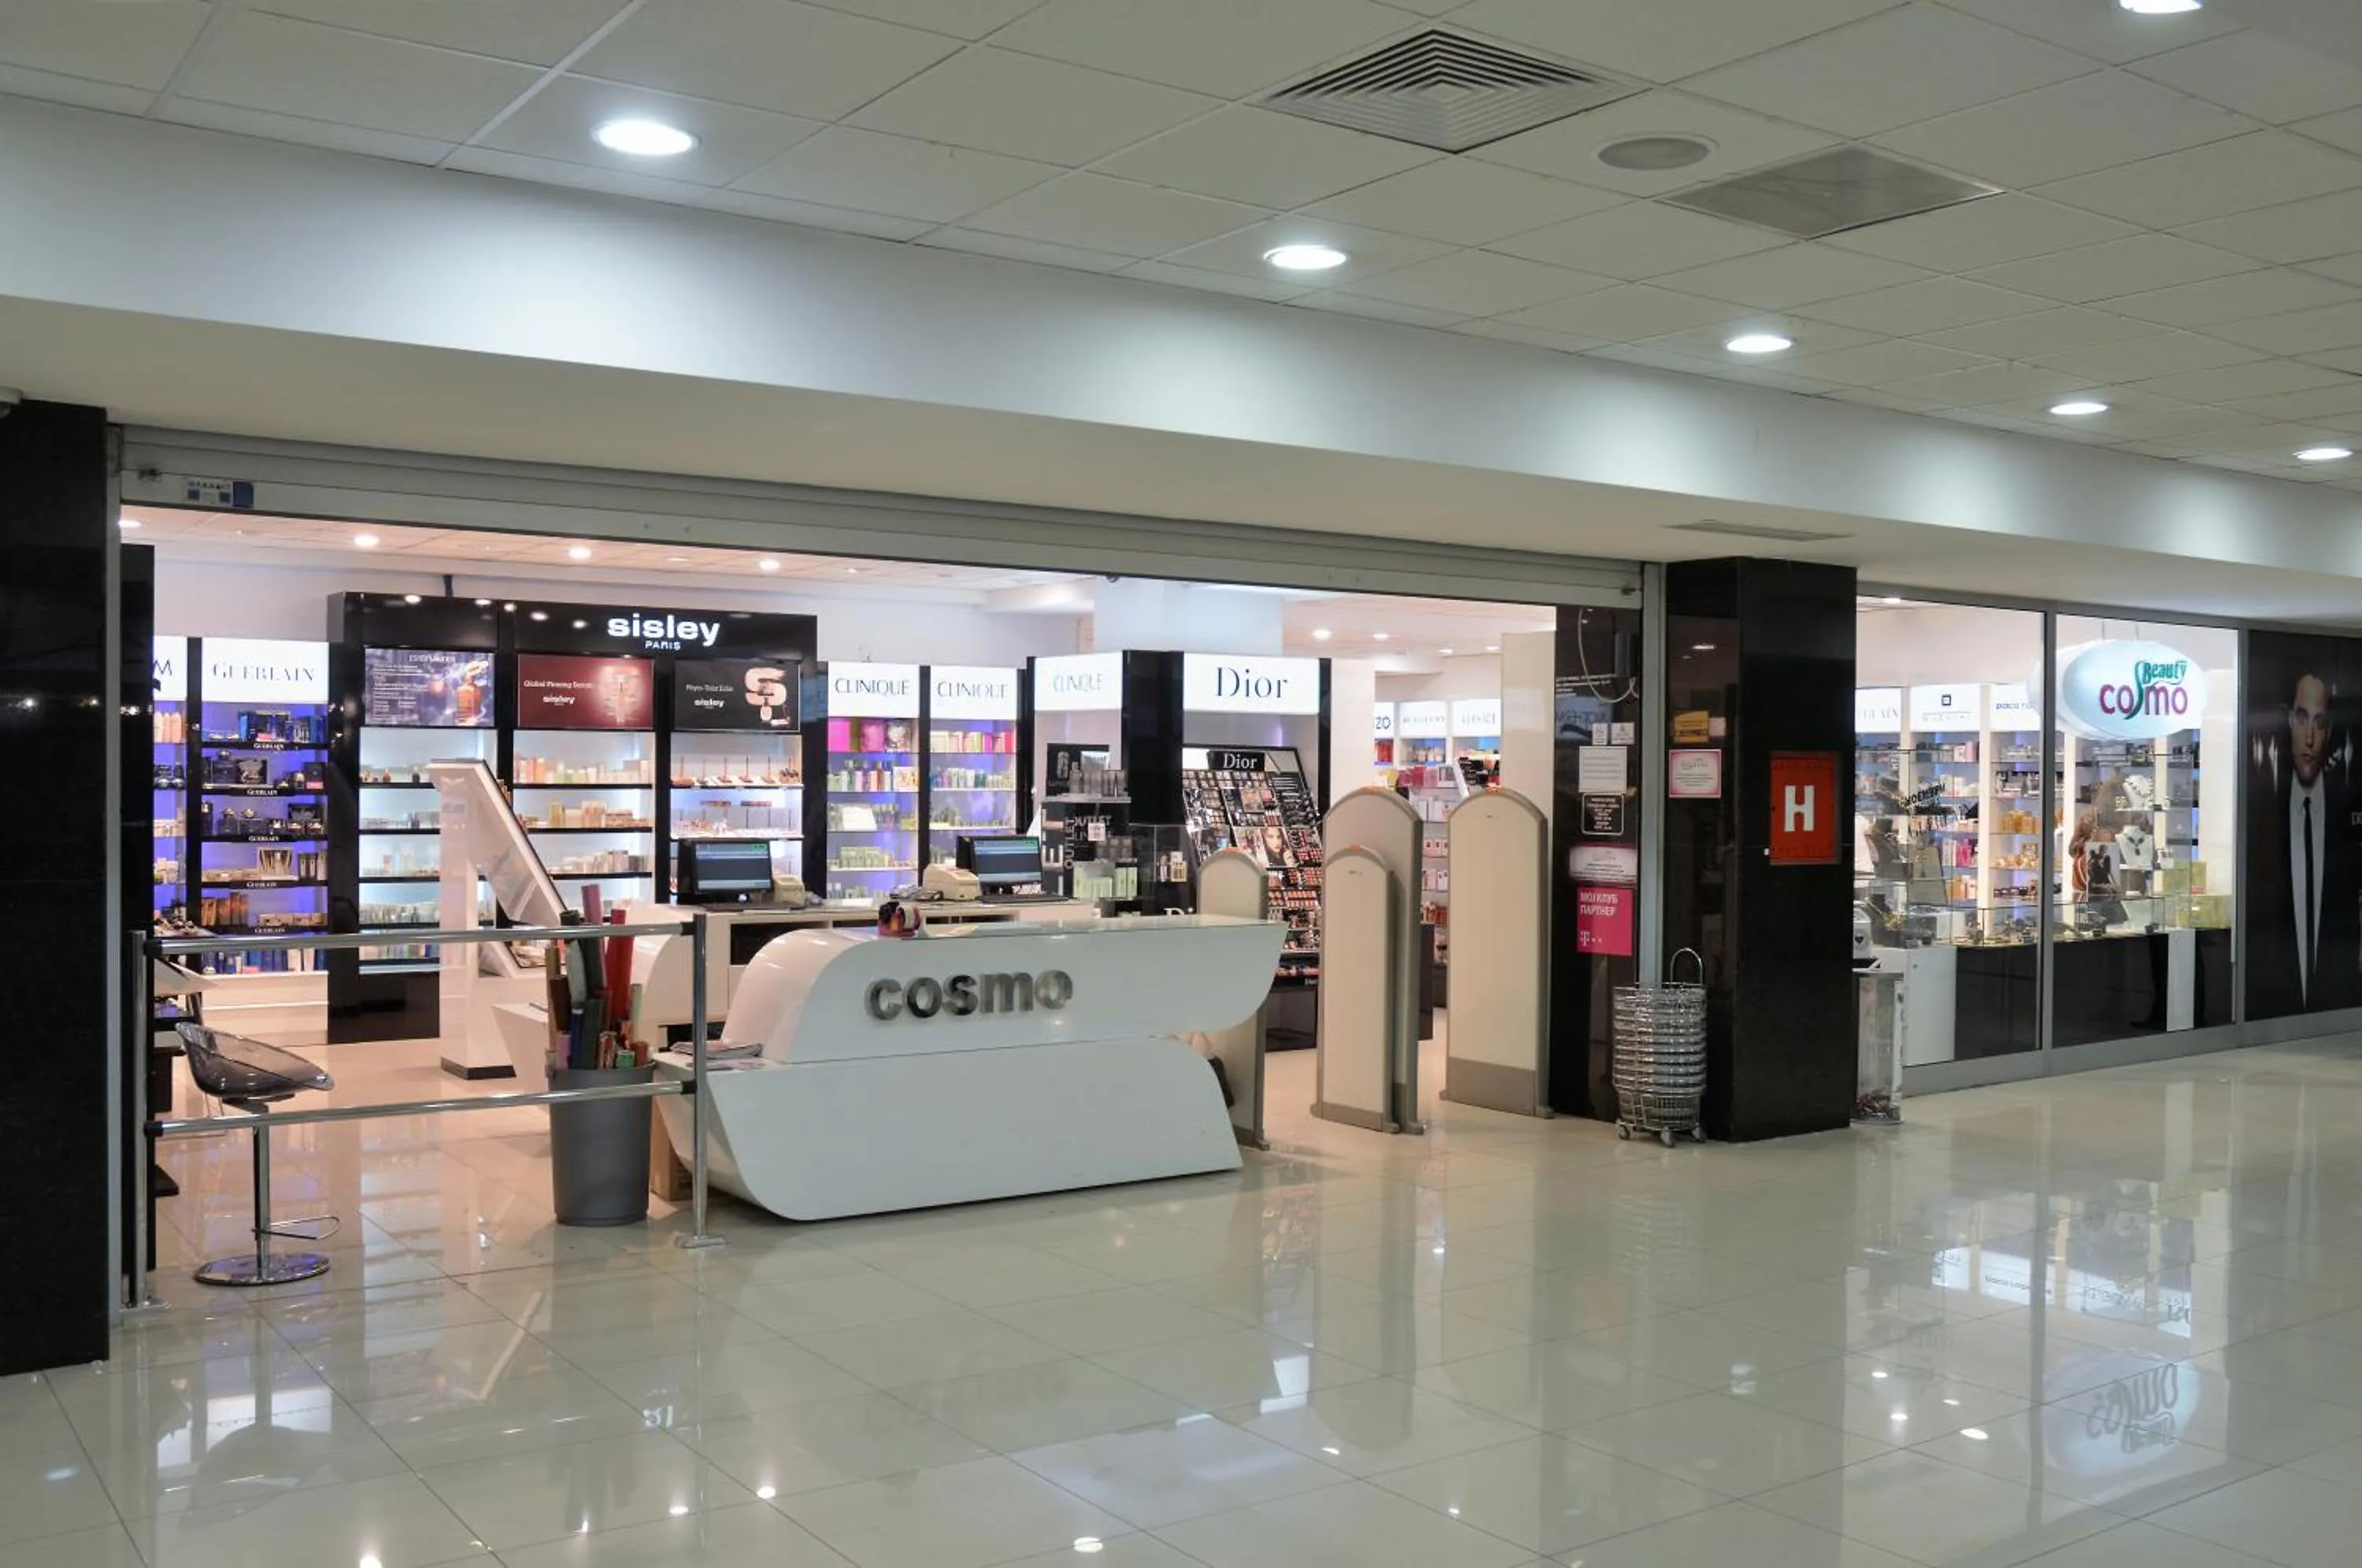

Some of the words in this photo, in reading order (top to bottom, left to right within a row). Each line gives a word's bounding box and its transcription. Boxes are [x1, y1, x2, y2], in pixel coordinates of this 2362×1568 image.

[607, 613, 720, 646] sisley
[645, 641, 681, 650] PARIS
[1216, 667, 1288, 698] Dior
[2142, 660, 2188, 685] Beauty
[835, 678, 909, 696] CLINIQUE
[937, 681, 1008, 699] CLINIQUE
[1223, 753, 1257, 769] Dior
[1784, 785, 1815, 832] H
[1064, 817, 1075, 869] OUTLET
[864, 969, 1074, 1021] cosmo
